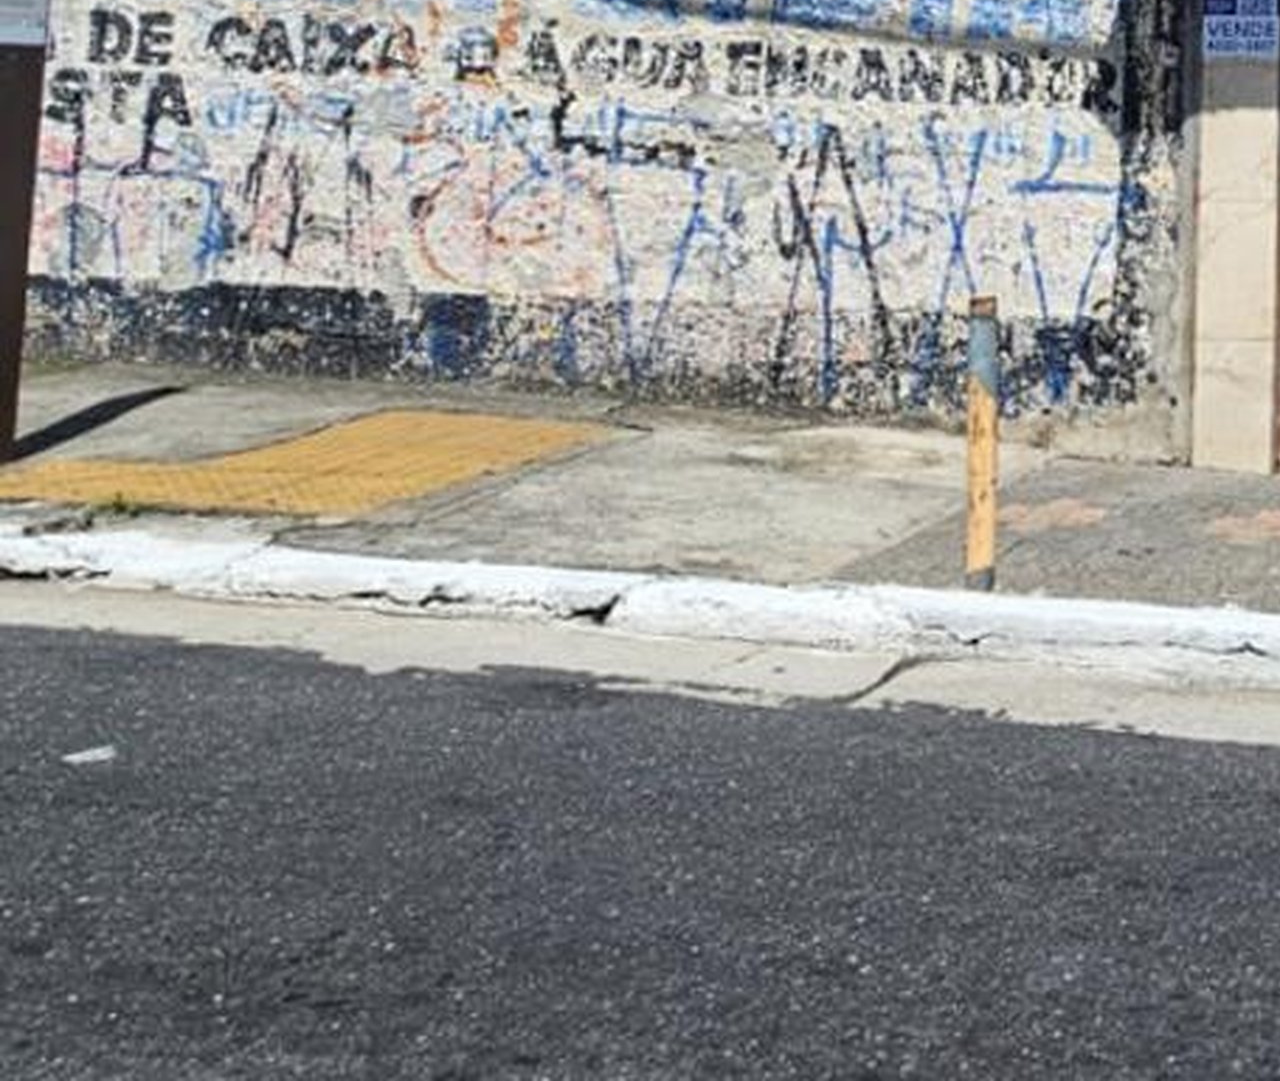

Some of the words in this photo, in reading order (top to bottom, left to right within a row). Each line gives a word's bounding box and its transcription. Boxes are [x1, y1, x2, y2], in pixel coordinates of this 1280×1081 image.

[88, 8, 174, 66] DE
[205, 14, 421, 76] CAIXA
[1207, 20, 1277, 38] VENDE
